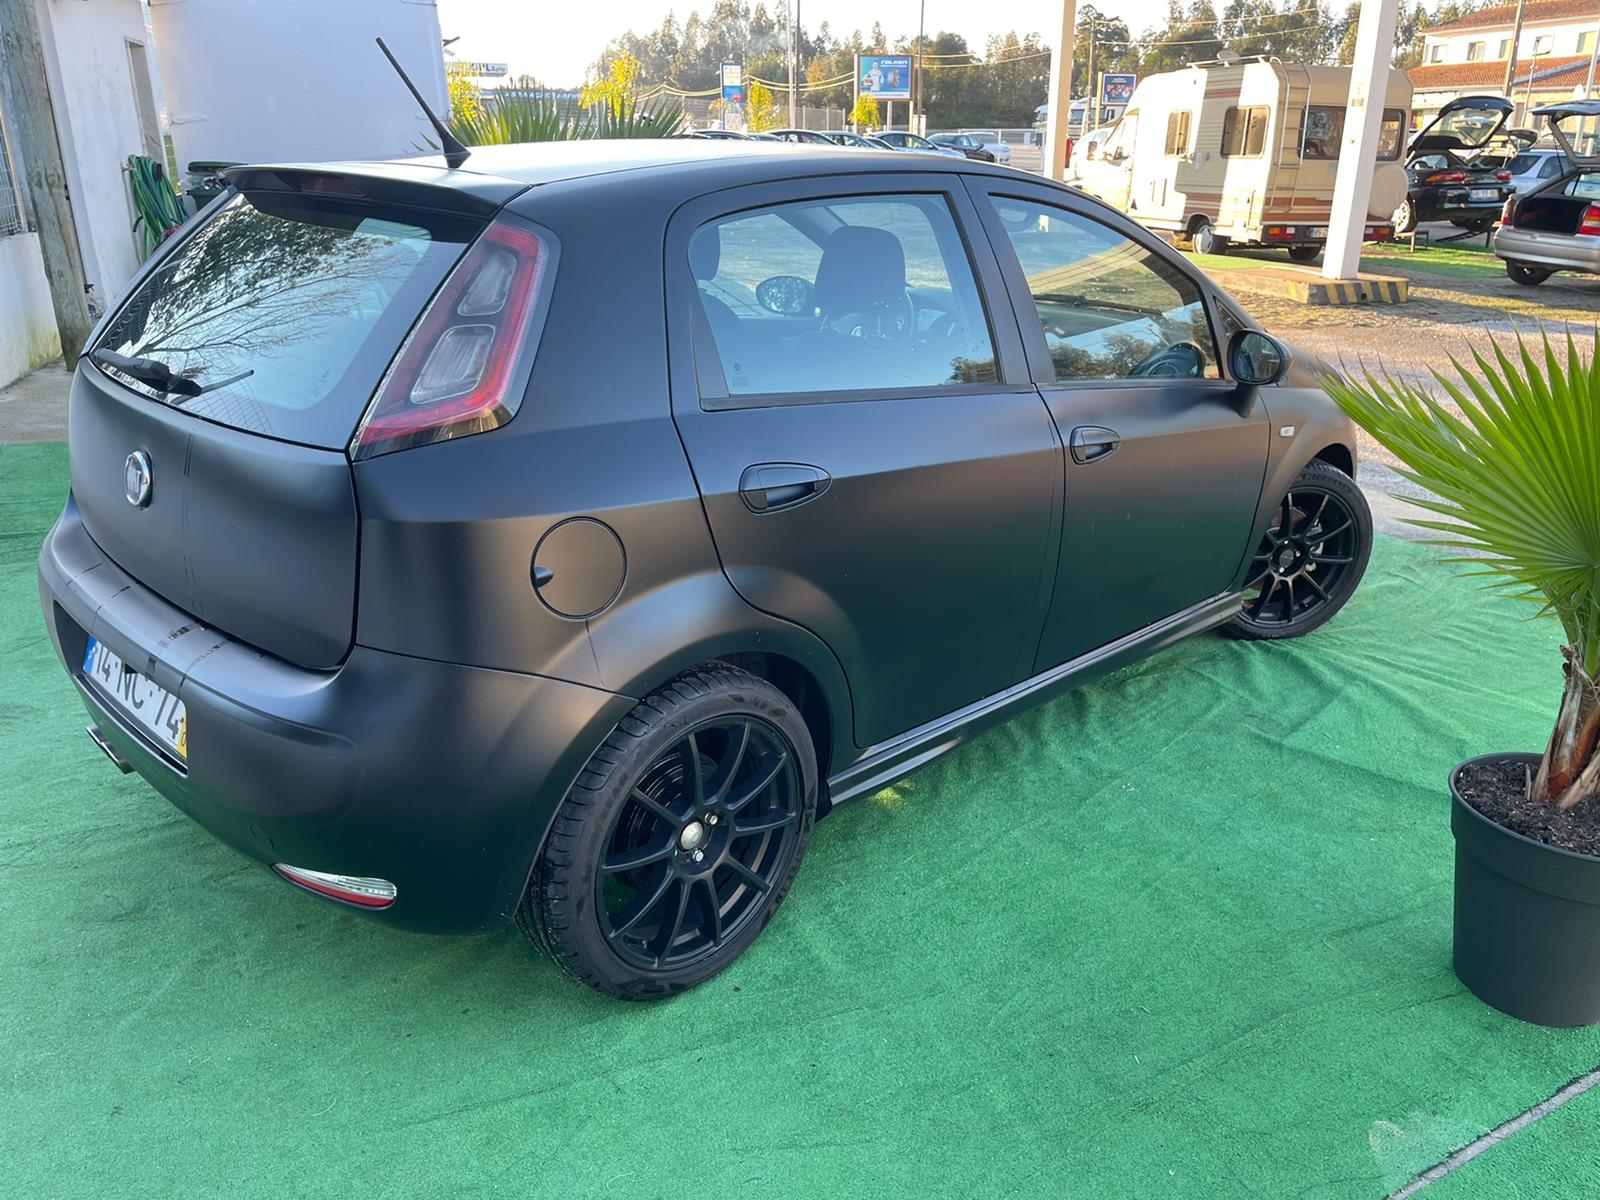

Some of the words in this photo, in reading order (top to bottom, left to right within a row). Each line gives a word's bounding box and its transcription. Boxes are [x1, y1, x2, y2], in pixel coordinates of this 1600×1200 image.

[97, 645, 110, 682] 14
[117, 662, 147, 710] NC
[154, 686, 181, 740] 74
